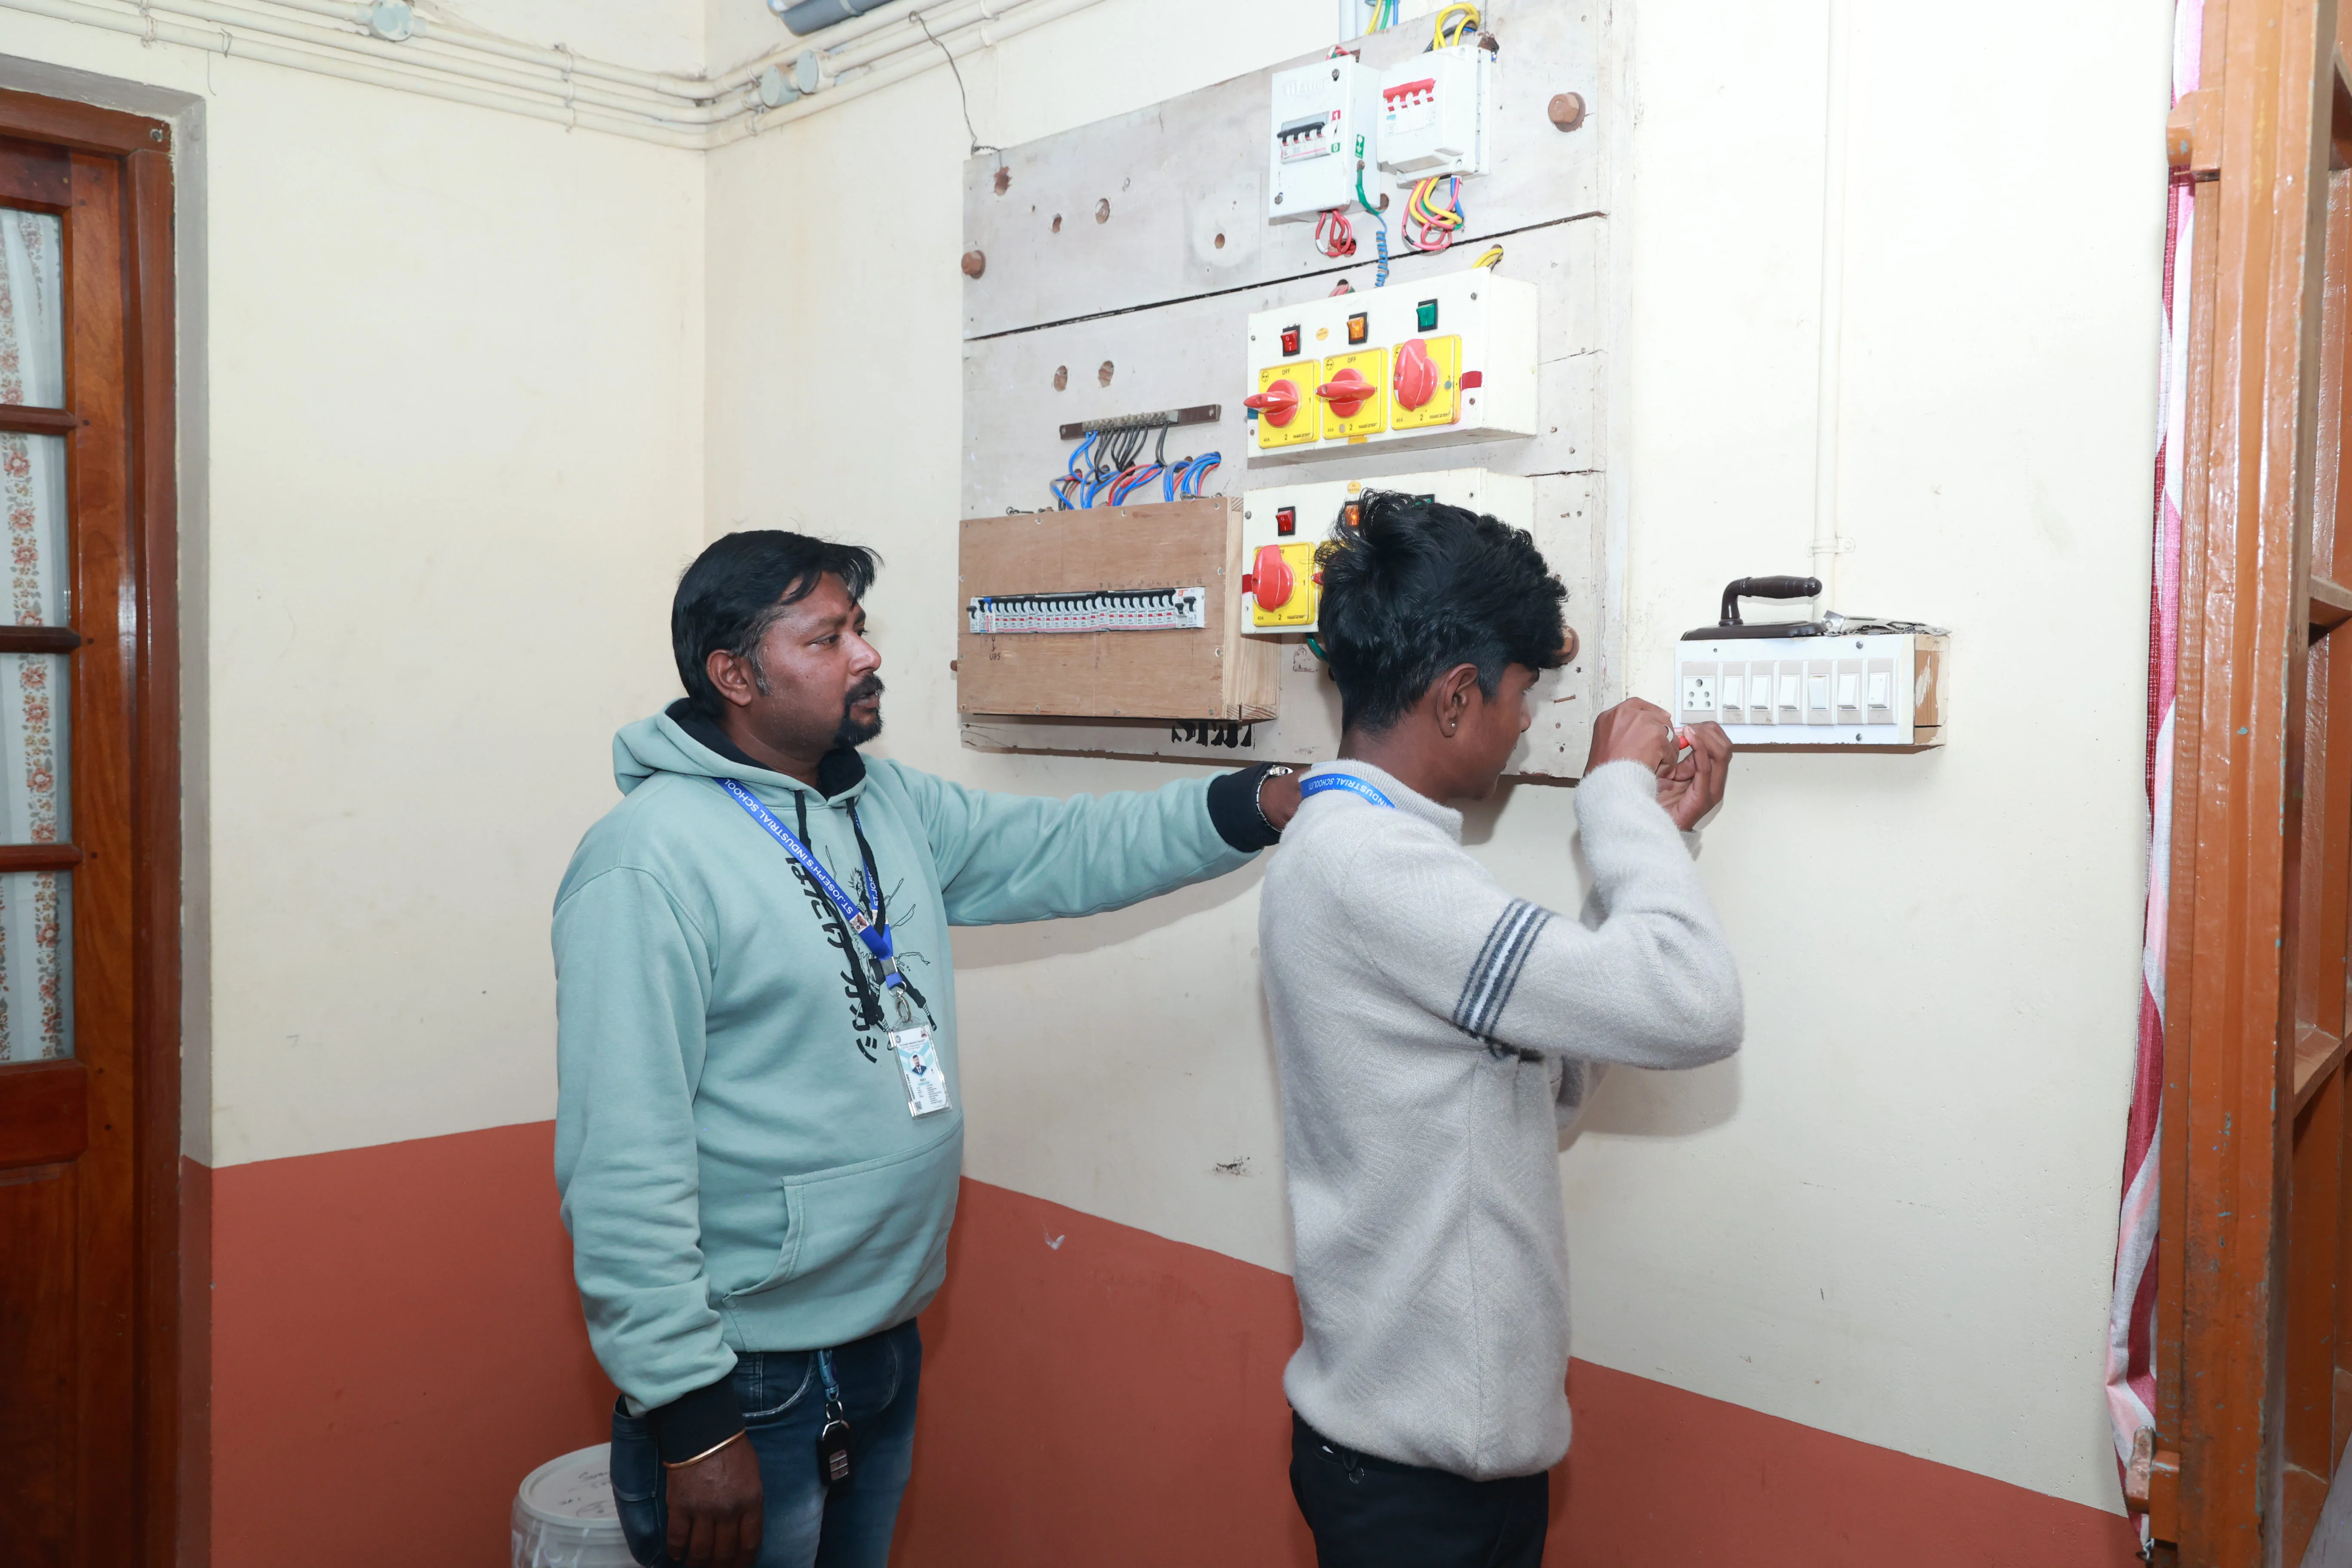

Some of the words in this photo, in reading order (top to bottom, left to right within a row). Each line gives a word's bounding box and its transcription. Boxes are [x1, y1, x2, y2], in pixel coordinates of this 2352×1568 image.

[724, 779, 759, 812] SCHOOL
[1337, 778, 1387, 808] INDUSTRIAL
[760, 810, 808, 861] INDUSTRIAL
[806, 859, 853, 914] ST.JOSEPH'S
